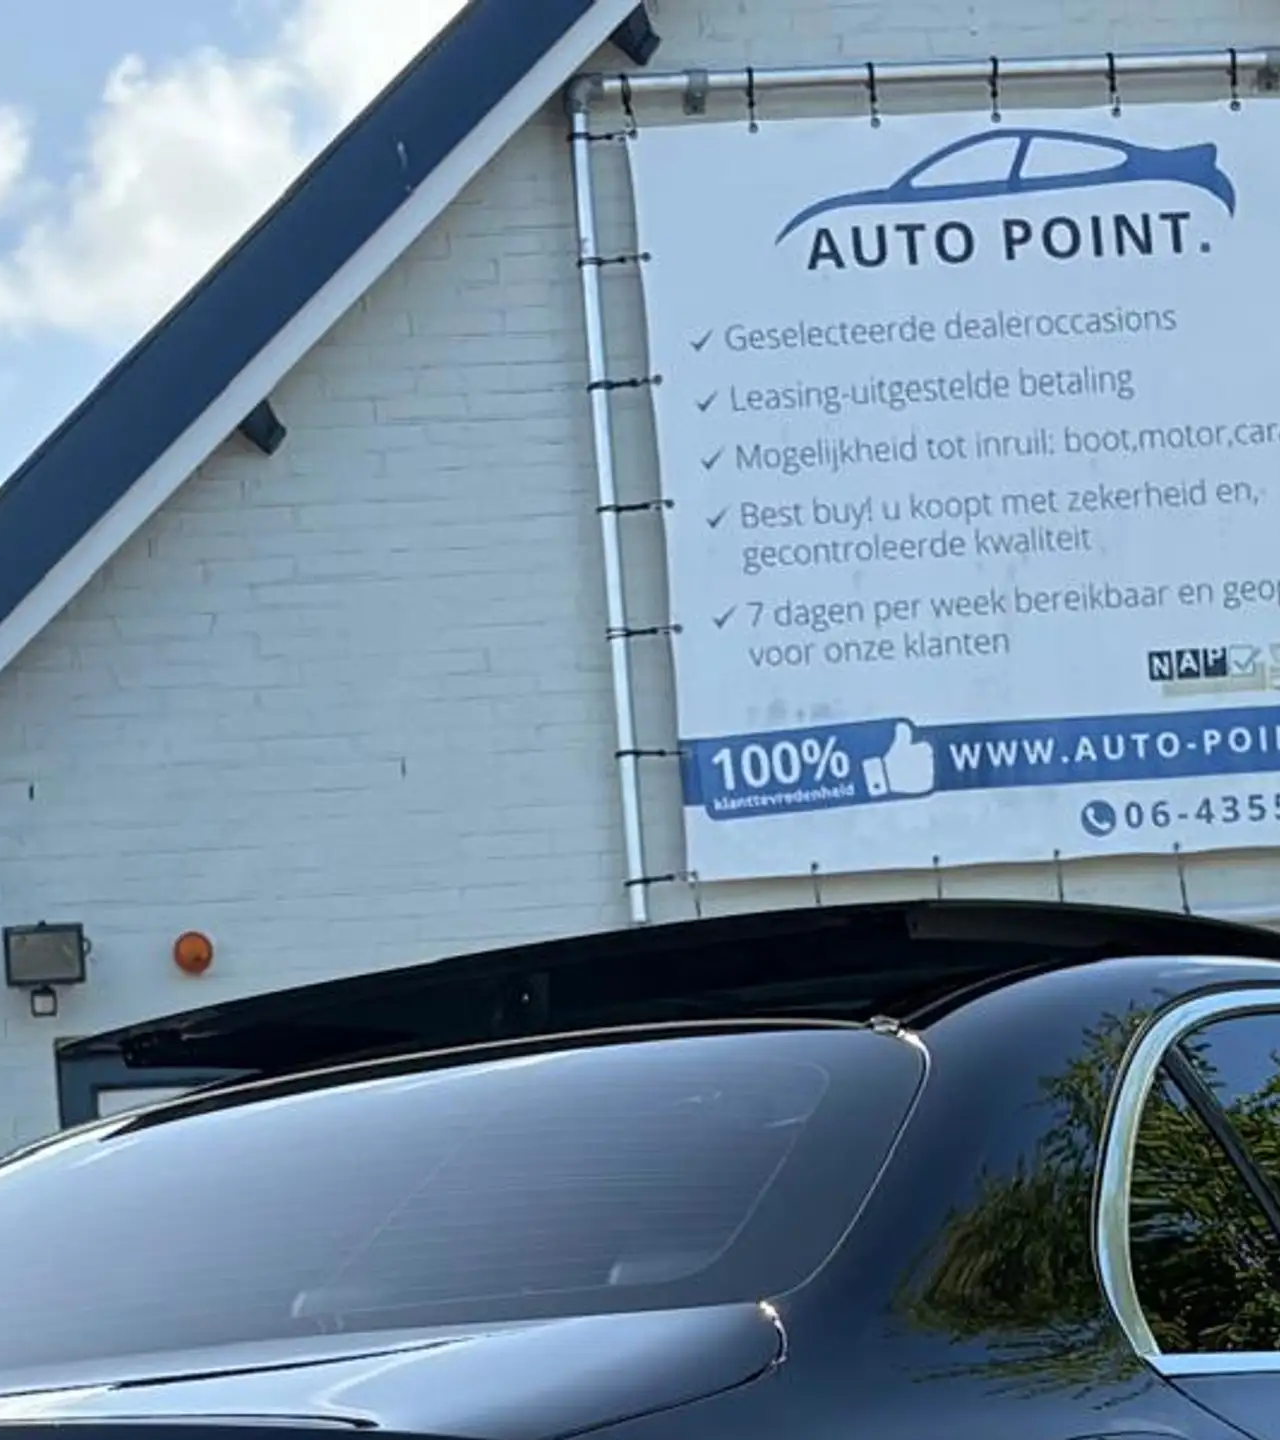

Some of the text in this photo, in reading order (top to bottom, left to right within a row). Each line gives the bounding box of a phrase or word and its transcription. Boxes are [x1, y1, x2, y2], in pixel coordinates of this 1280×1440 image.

[807, 211, 1211, 271] AUTO POINT.
[724, 307, 1177, 351] Geselecteerde dealeroccasions
[730, 366, 1135, 414] Leasing-uitgestelde betaling
[736, 428, 918, 475] Mogelijkheid
[928, 437, 966, 461] tot
[976, 427, 1055, 457] inruil:
[741, 500, 802, 529] Best
[814, 496, 873, 530] buy!
[883, 500, 900, 521] u
[910, 493, 992, 525] koopt
[1001, 489, 1059, 516] met
[1067, 479, 1207, 513] zekerheid
[742, 526, 1091, 576] gecontroleerde kwaliteit
[746, 601, 764, 628] 7
[774, 600, 864, 633] dagen
[874, 598, 921, 628] per
[930, 587, 1006, 618] week
[1015, 581, 1168, 615] bereikbaar
[1178, 583, 1214, 605] en
[749, 631, 1010, 668] voor onze klanten
[1150, 648, 1227, 680] NAP
[711, 735, 851, 791] 100%
